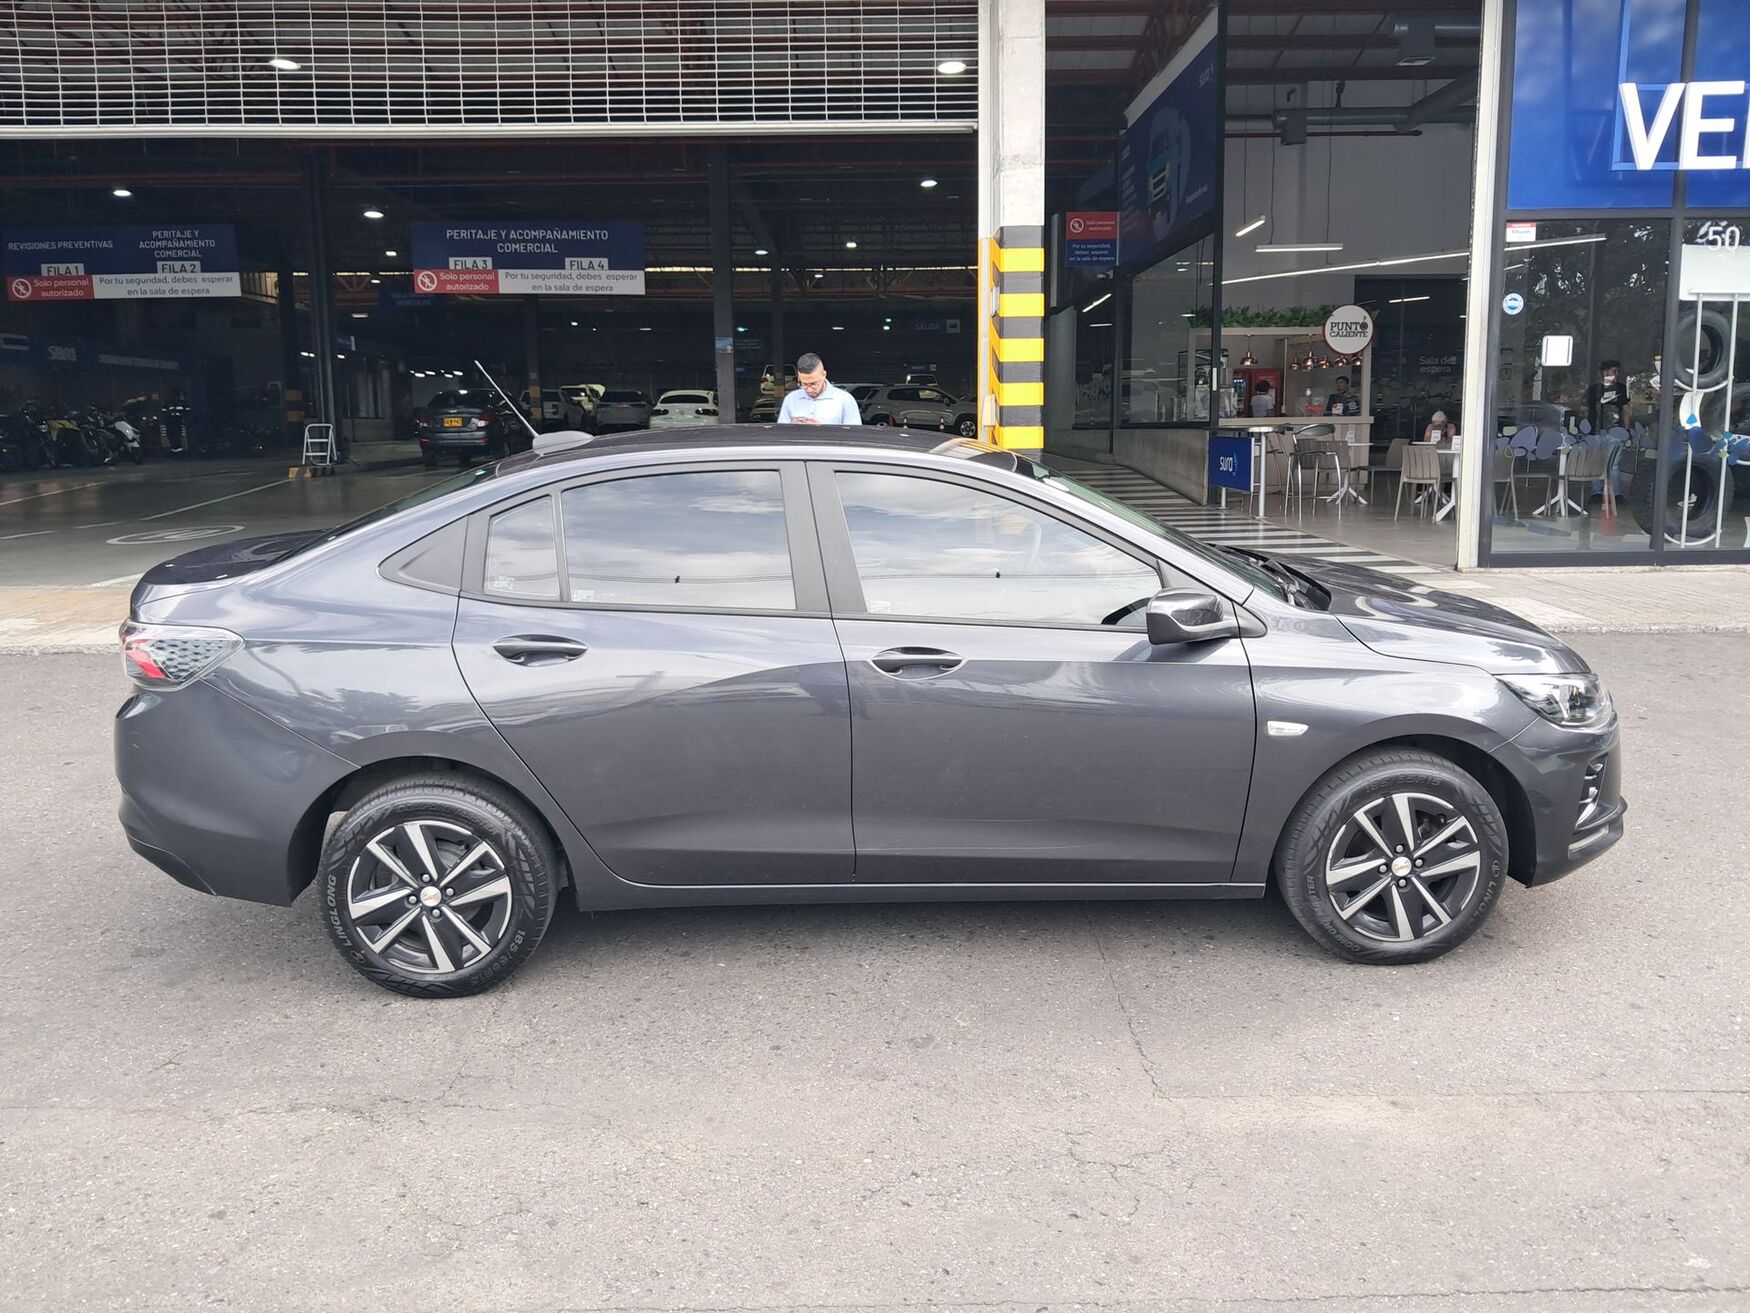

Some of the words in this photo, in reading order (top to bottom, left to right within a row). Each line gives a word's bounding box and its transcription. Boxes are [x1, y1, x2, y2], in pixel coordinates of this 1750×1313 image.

[1618, 80, 1750, 170] VE
[152, 230, 192, 239] PERITAJE
[193, 230, 200, 238] Y
[446, 229, 498, 240] PERITAJE
[499, 230, 507, 240] Y
[509, 227, 609, 240] ACOMPAÑAMIENTO
[8, 242, 57, 251] REVISIONES
[58, 240, 114, 249] PREVENTIVAS
[139, 238, 216, 249] ACOMPAÑAMIENTO
[497, 242, 559, 253] COMERCIAL
[154, 249, 202, 258] COMERCIAL
[161, 263, 188, 273] FILA
[190, 263, 197, 273] 2
[454, 259, 480, 269] FILA
[481, 260, 488, 269] 3
[570, 260, 596, 270] FILA
[597, 260, 604, 270] 4
[47, 265, 73, 275] FILA
[74, 266, 79, 275] 1
[99, 277, 113, 285] Por
[115, 277, 124, 285] tu
[171, 275, 199, 284] debes
[201, 275, 233, 285] esperar
[439, 272, 458, 280] Solo
[459, 272, 495, 282] personal
[505, 271, 518, 280] Por
[520, 272, 529, 280] tu
[530, 272, 575, 282] seguridad,
[576, 273, 602, 281] debes
[606, 273, 638, 282] esperar
[33, 279, 53, 287] Solo
[54, 278, 90, 289] personal
[446, 282, 490, 291] autorizado
[532, 284, 543, 292] en
[544, 283, 552, 292] la
[553, 283, 571, 292] sala
[572, 283, 583, 292] de
[584, 284, 614, 293] espera
[41, 289, 85, 297] autorizado
[127, 288, 139, 296] en
[140, 287, 148, 296] la
[149, 287, 167, 296] sala
[168, 287, 179, 296] de
[181, 287, 211, 297] espera
[1330, 321, 1369, 331] PUNTO
[327, 874, 353, 948] LINGLONG
